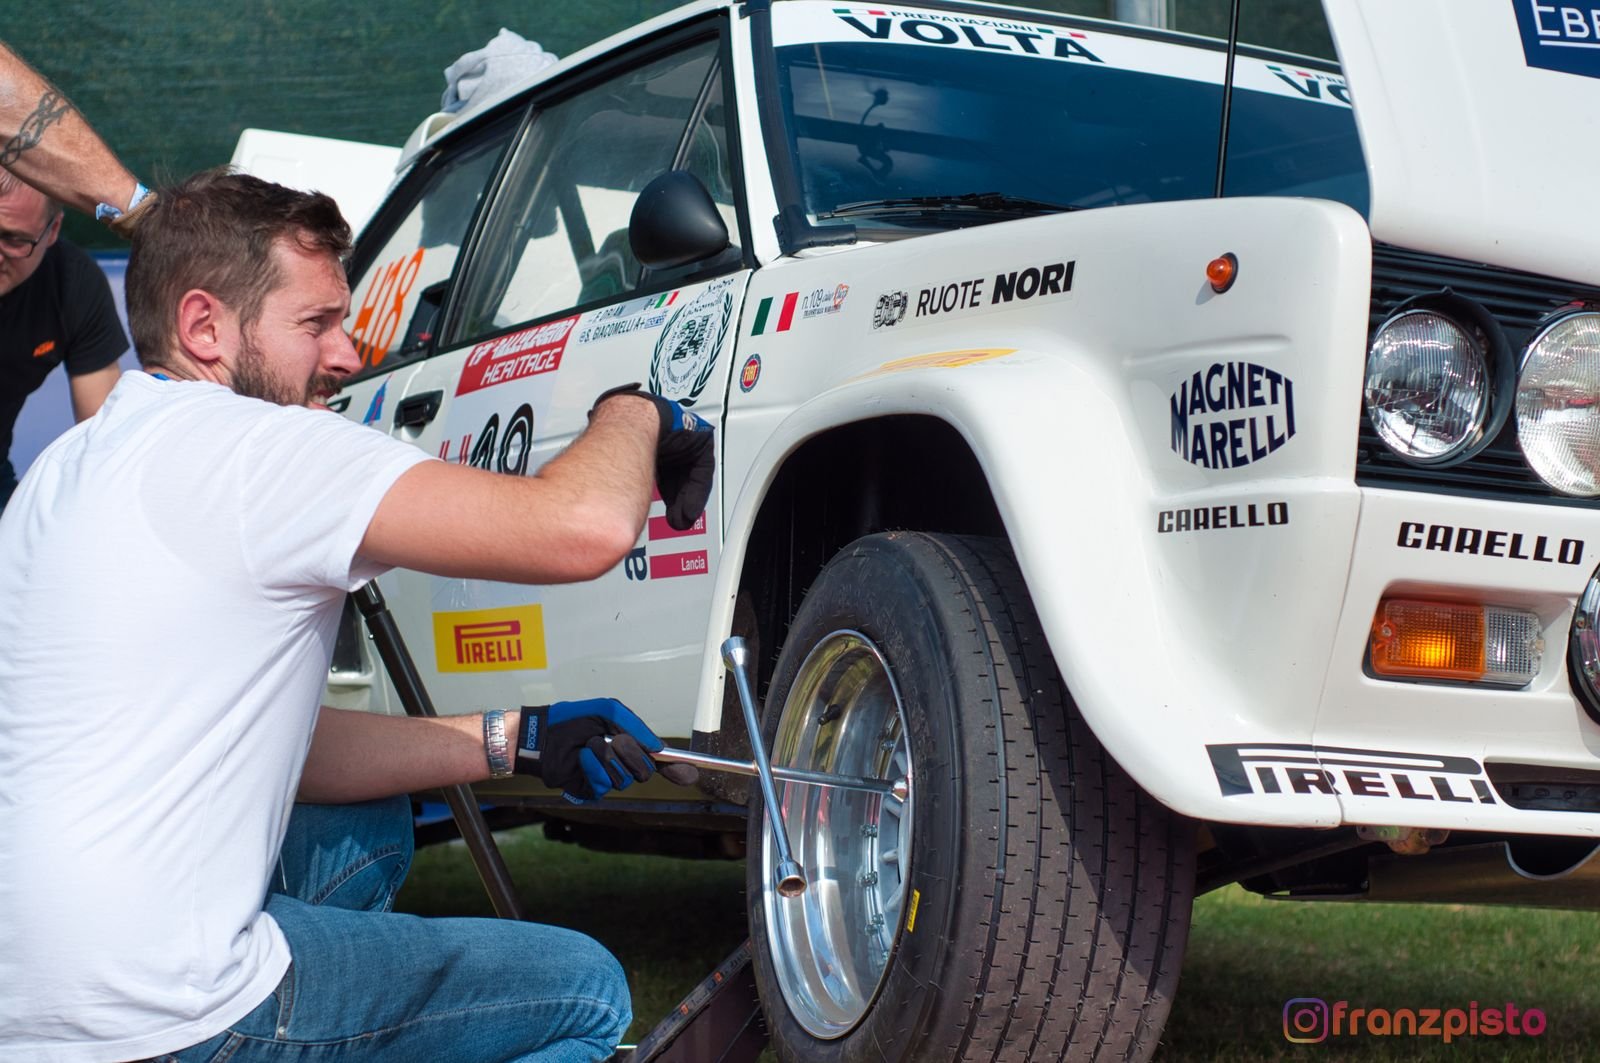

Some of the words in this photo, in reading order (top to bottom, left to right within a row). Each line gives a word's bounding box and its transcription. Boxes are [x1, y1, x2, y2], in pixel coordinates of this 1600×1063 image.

[838, 16, 1106, 63] VOLTA
[890, 11, 1034, 32] PREPARAZIONI
[915, 278, 985, 318] RUOTE
[991, 260, 1076, 305] NORI
[480, 346, 563, 386] HERITAGE
[1170, 361, 1295, 430] MAGNETI
[1170, 409, 1297, 470] MARELLI
[1157, 501, 1290, 533] CARELLO
[680, 555, 706, 572] Lancia
[1396, 521, 1585, 565] CARELLO
[454, 620, 523, 664] PIRELLI
[1205, 743, 1498, 806] PIRELLI
